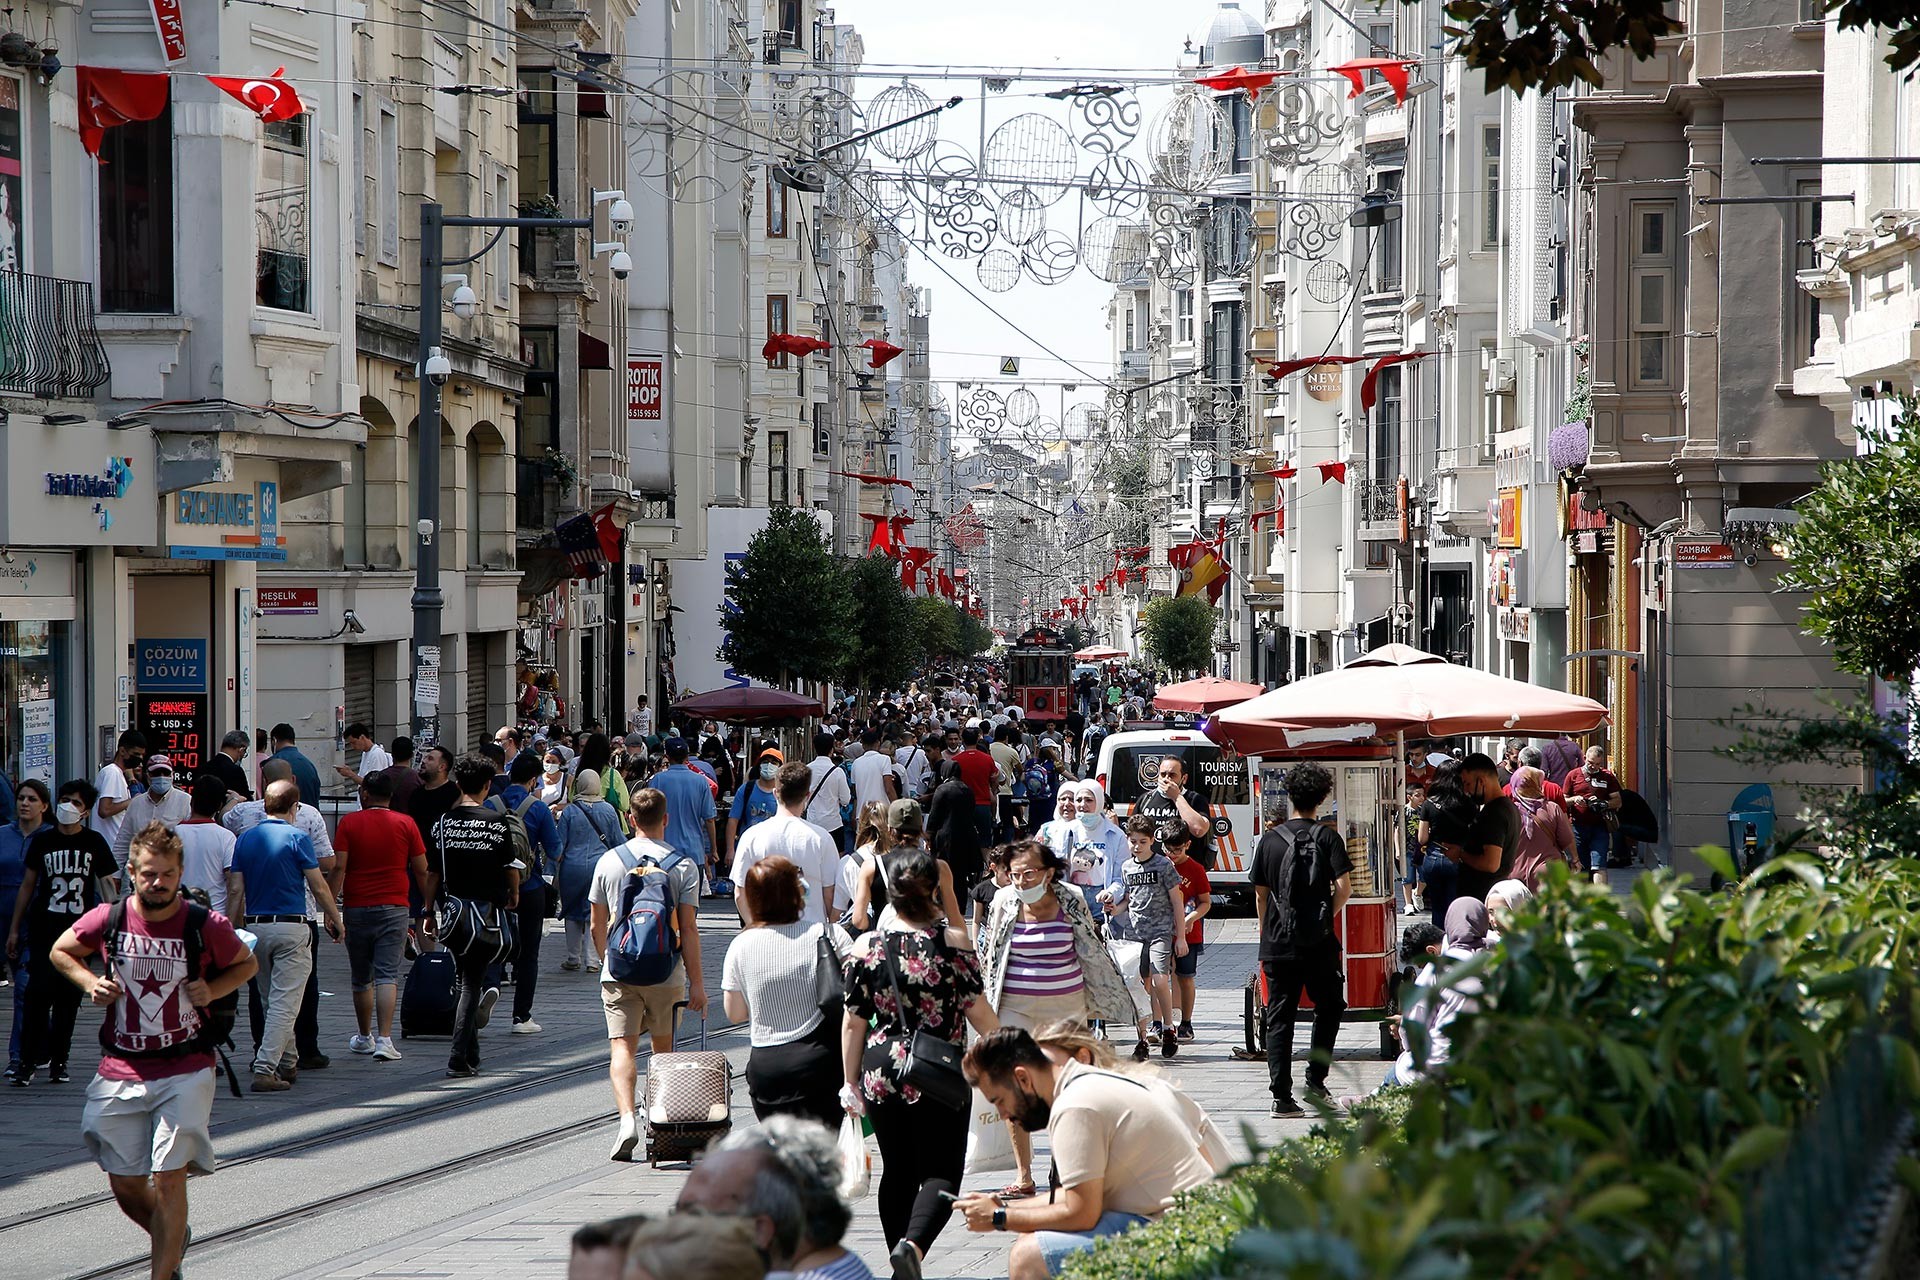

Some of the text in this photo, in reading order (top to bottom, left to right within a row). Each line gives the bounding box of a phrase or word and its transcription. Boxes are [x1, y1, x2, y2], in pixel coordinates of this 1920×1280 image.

[628, 364, 659, 385] ROTİK
[1310, 384, 1342, 392] HOTELS
[629, 386, 659, 404] HOP
[176, 490, 254, 526] EXCHANGE
[1678, 546, 1711, 554] ZAMBAK
[261, 590, 297, 601] MEŞELİK
[145, 645, 198, 662] ÇÖZÜM
[145, 663, 197, 677] DÖVİZ
[150, 703, 192, 713] CHANGE
[163, 719, 181, 729] USD
[1200, 762, 1243, 772] TOURISM
[1205, 775, 1239, 786] POLICE
[1143, 807, 1179, 817] BALMAI
[44, 849, 92, 877] BULLS
[48, 876, 84, 914] 23
